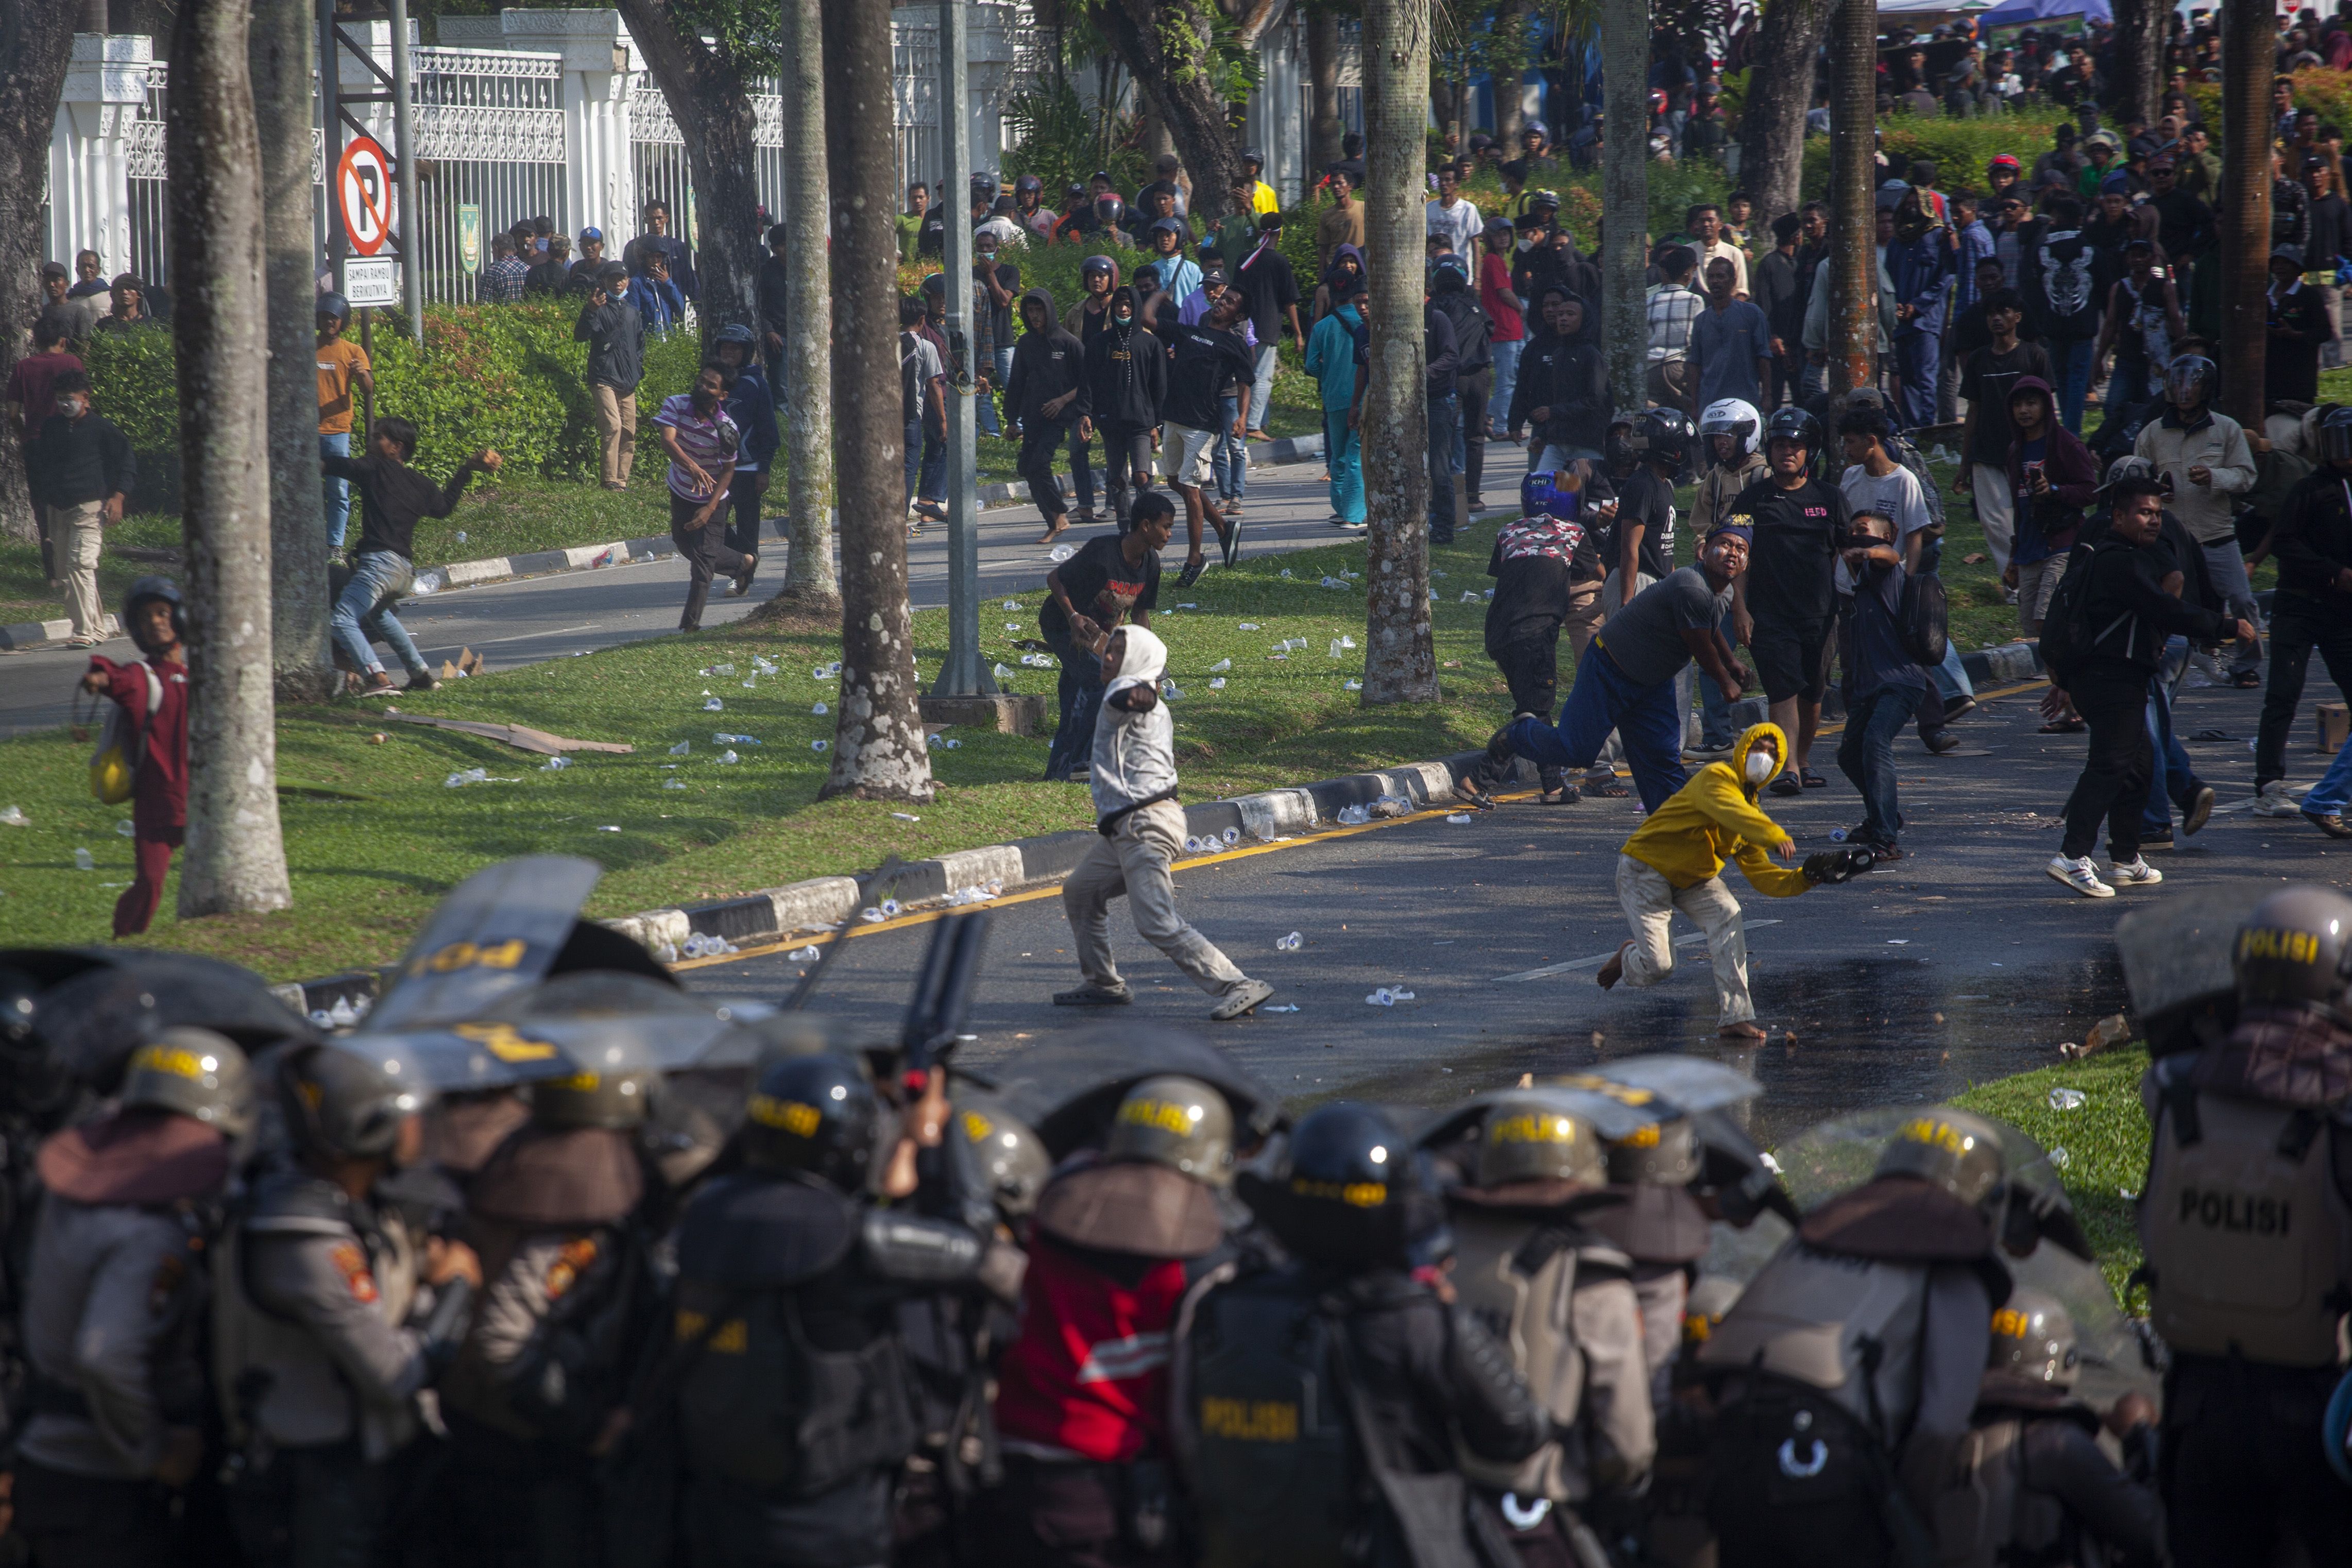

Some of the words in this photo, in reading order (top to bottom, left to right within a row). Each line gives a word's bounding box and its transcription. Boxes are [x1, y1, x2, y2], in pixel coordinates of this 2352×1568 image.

[349, 268, 370, 281] SAMPAI
[370, 267, 389, 280] RAMBU
[352, 284, 387, 298] BERIKUTNYA
[1191, 335, 1214, 346] CALIFORNIA
[2239, 928, 2319, 964] POLISI
[2180, 1186, 2291, 1234] POLISI
[1202, 1397, 1299, 1442] POLISI
